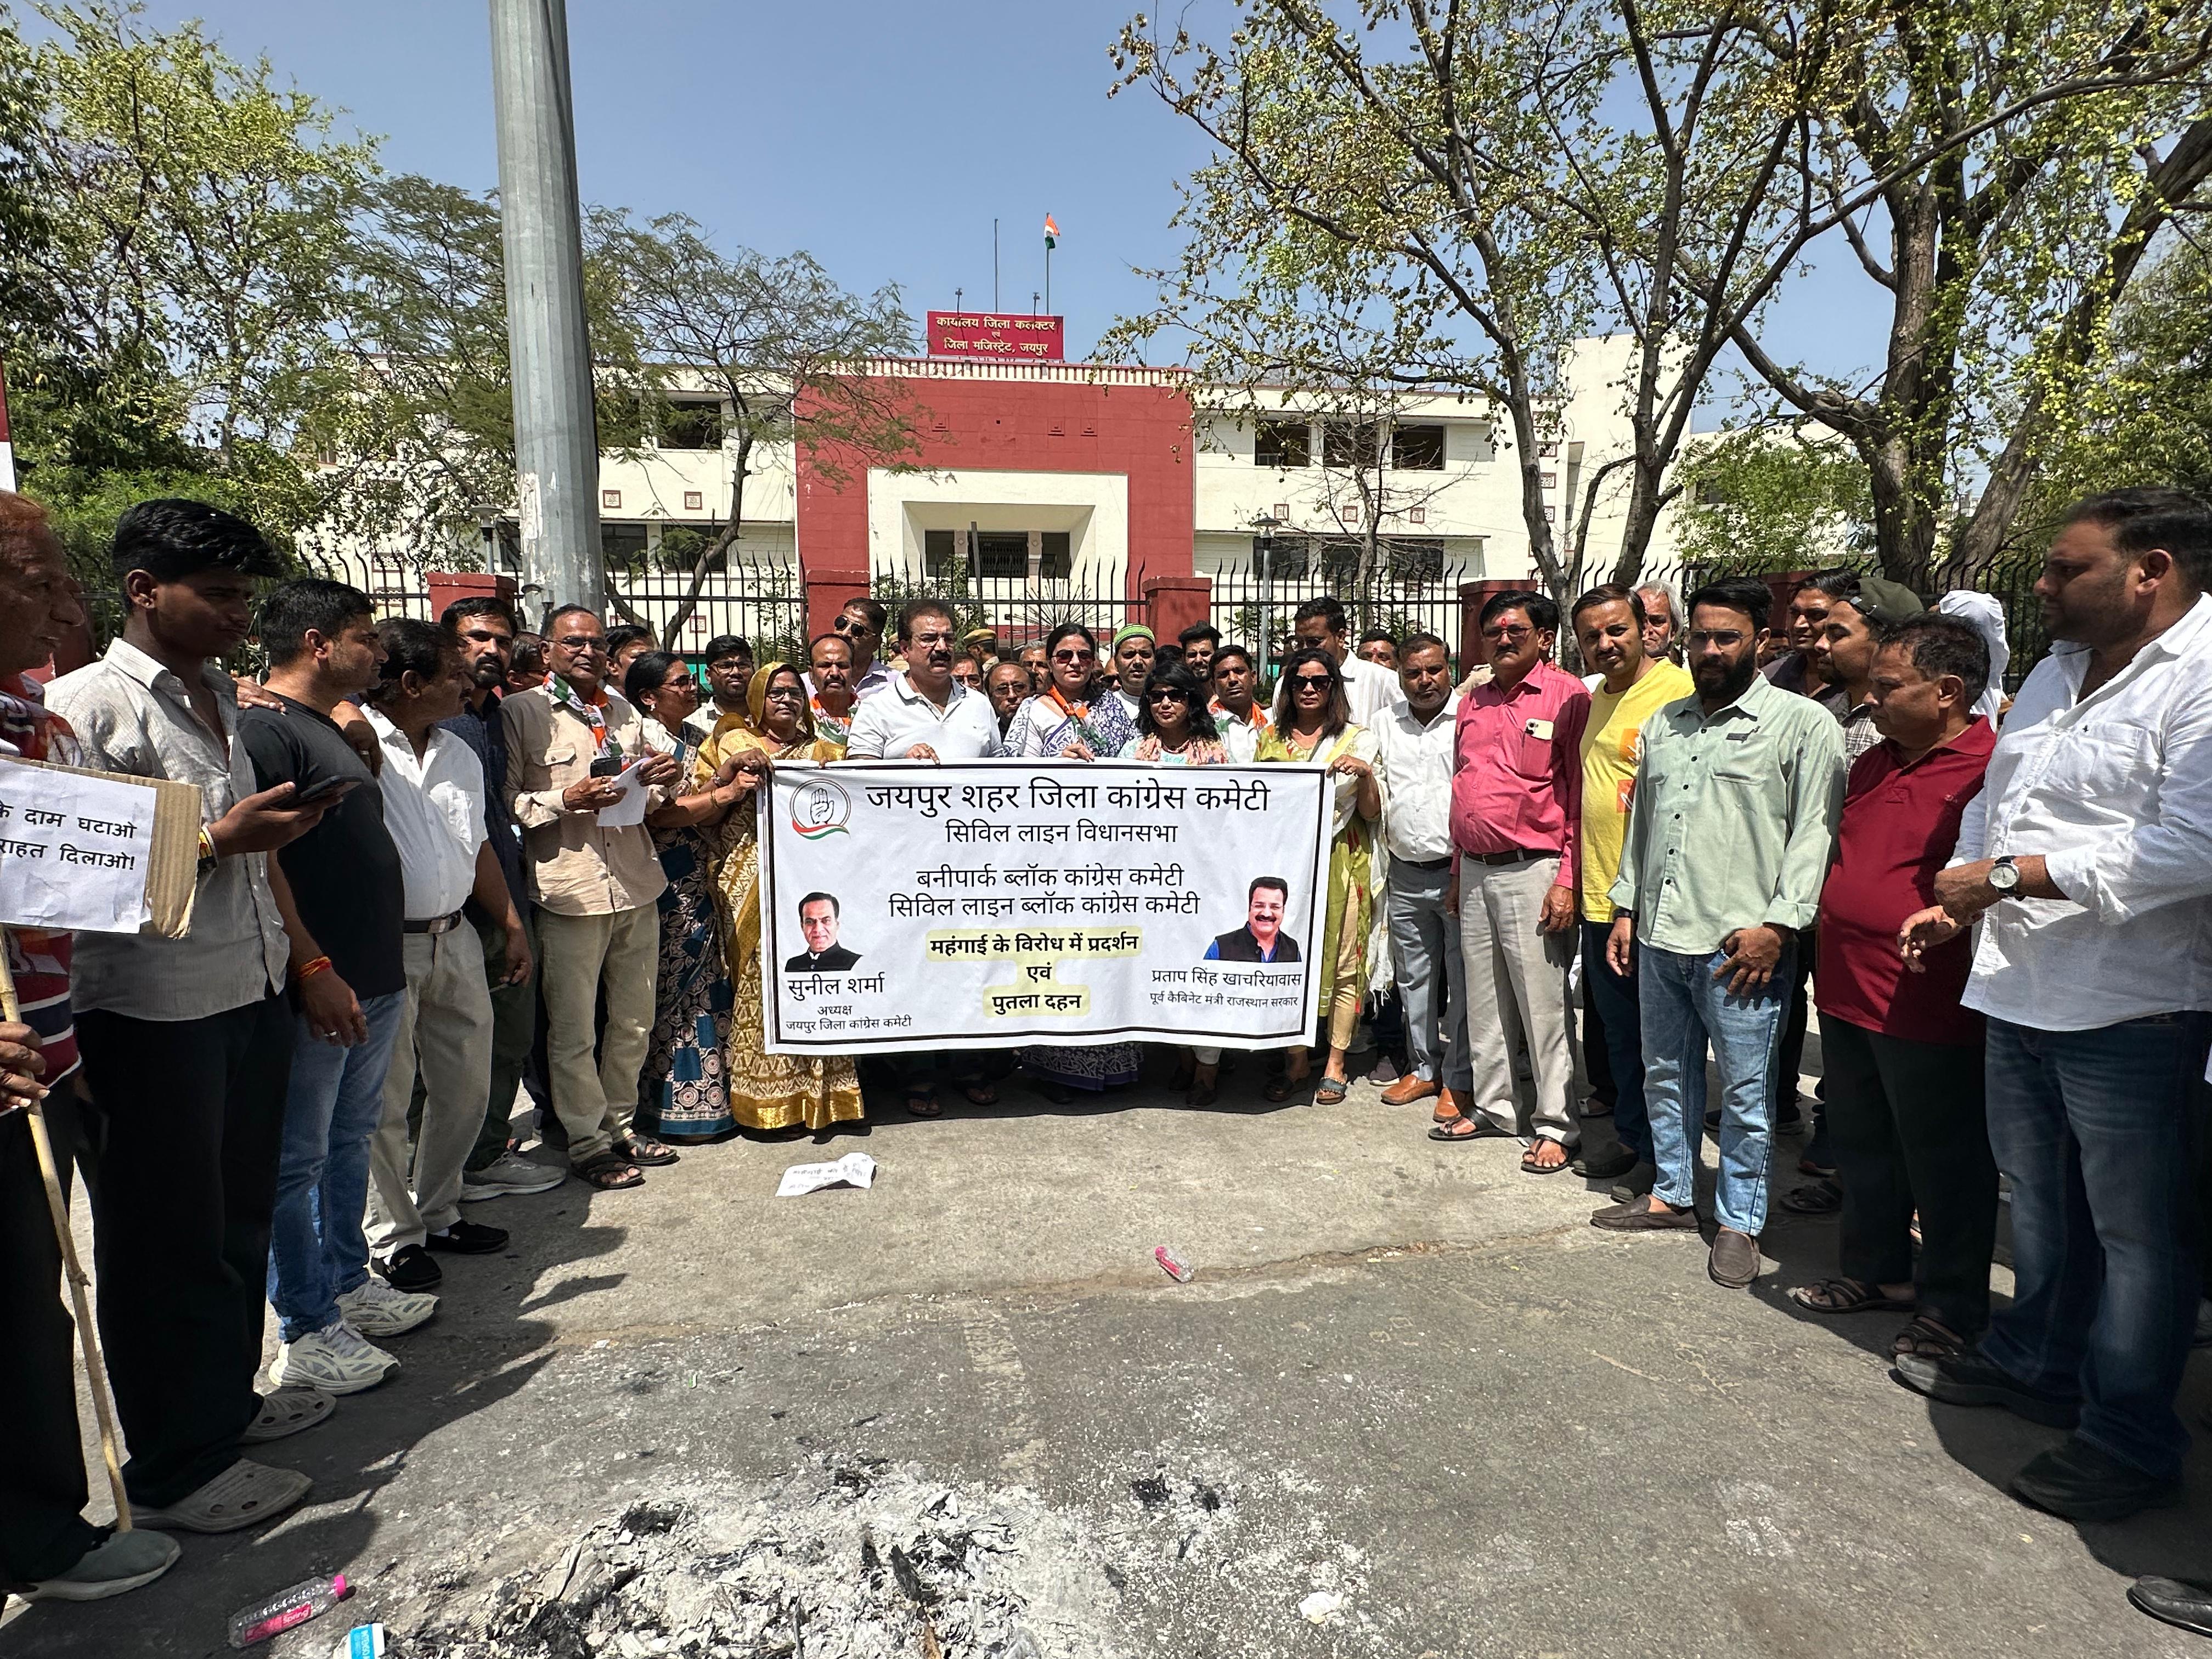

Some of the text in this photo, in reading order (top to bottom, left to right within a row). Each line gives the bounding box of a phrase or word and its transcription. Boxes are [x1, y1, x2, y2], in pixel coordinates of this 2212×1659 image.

[936, 315, 979, 329] कार्यालय
[983, 316, 1011, 330] जिला
[991, 330, 1001, 339] एवं
[944, 337, 1049, 356] जिला मजिस्ट्रेट, जयपुर
[865, 776, 1271, 818] जयपुर शहर जिला कांग्रेस कमेटी
[24, 809, 67, 827] दाम
[77, 816, 137, 839] घटाओ
[945, 820, 1178, 845] सिविल लाइन विधानसभा
[0, 838, 136, 871] राहत दिलाओ!
[916, 862, 1185, 888] बनीपार्क ब्लॉक कांग्रेस कमेटी
[888, 891, 1201, 918] सिविल लाइन ब्लॉक कांग्रेस कमेटी
[930, 931, 1139, 957] महंगाई के विरोध में प्रदर्शन
[1026, 961, 1052, 983] एवं
[1152, 967, 1302, 987] प्रताप सिंह खाचरियावास
[787, 971, 885, 1002] सुनील शर्मा
[817, 1005, 853, 1016] अध्यक्ष
[992, 995, 1082, 1015] पुतला दहन
[1150, 991, 1298, 1008] पूर्व कैबिनेट मंत्री राजस्थान सरकार
[786, 1014, 912, 1034] जयपुर जिला कांग्रेस कमेटी
